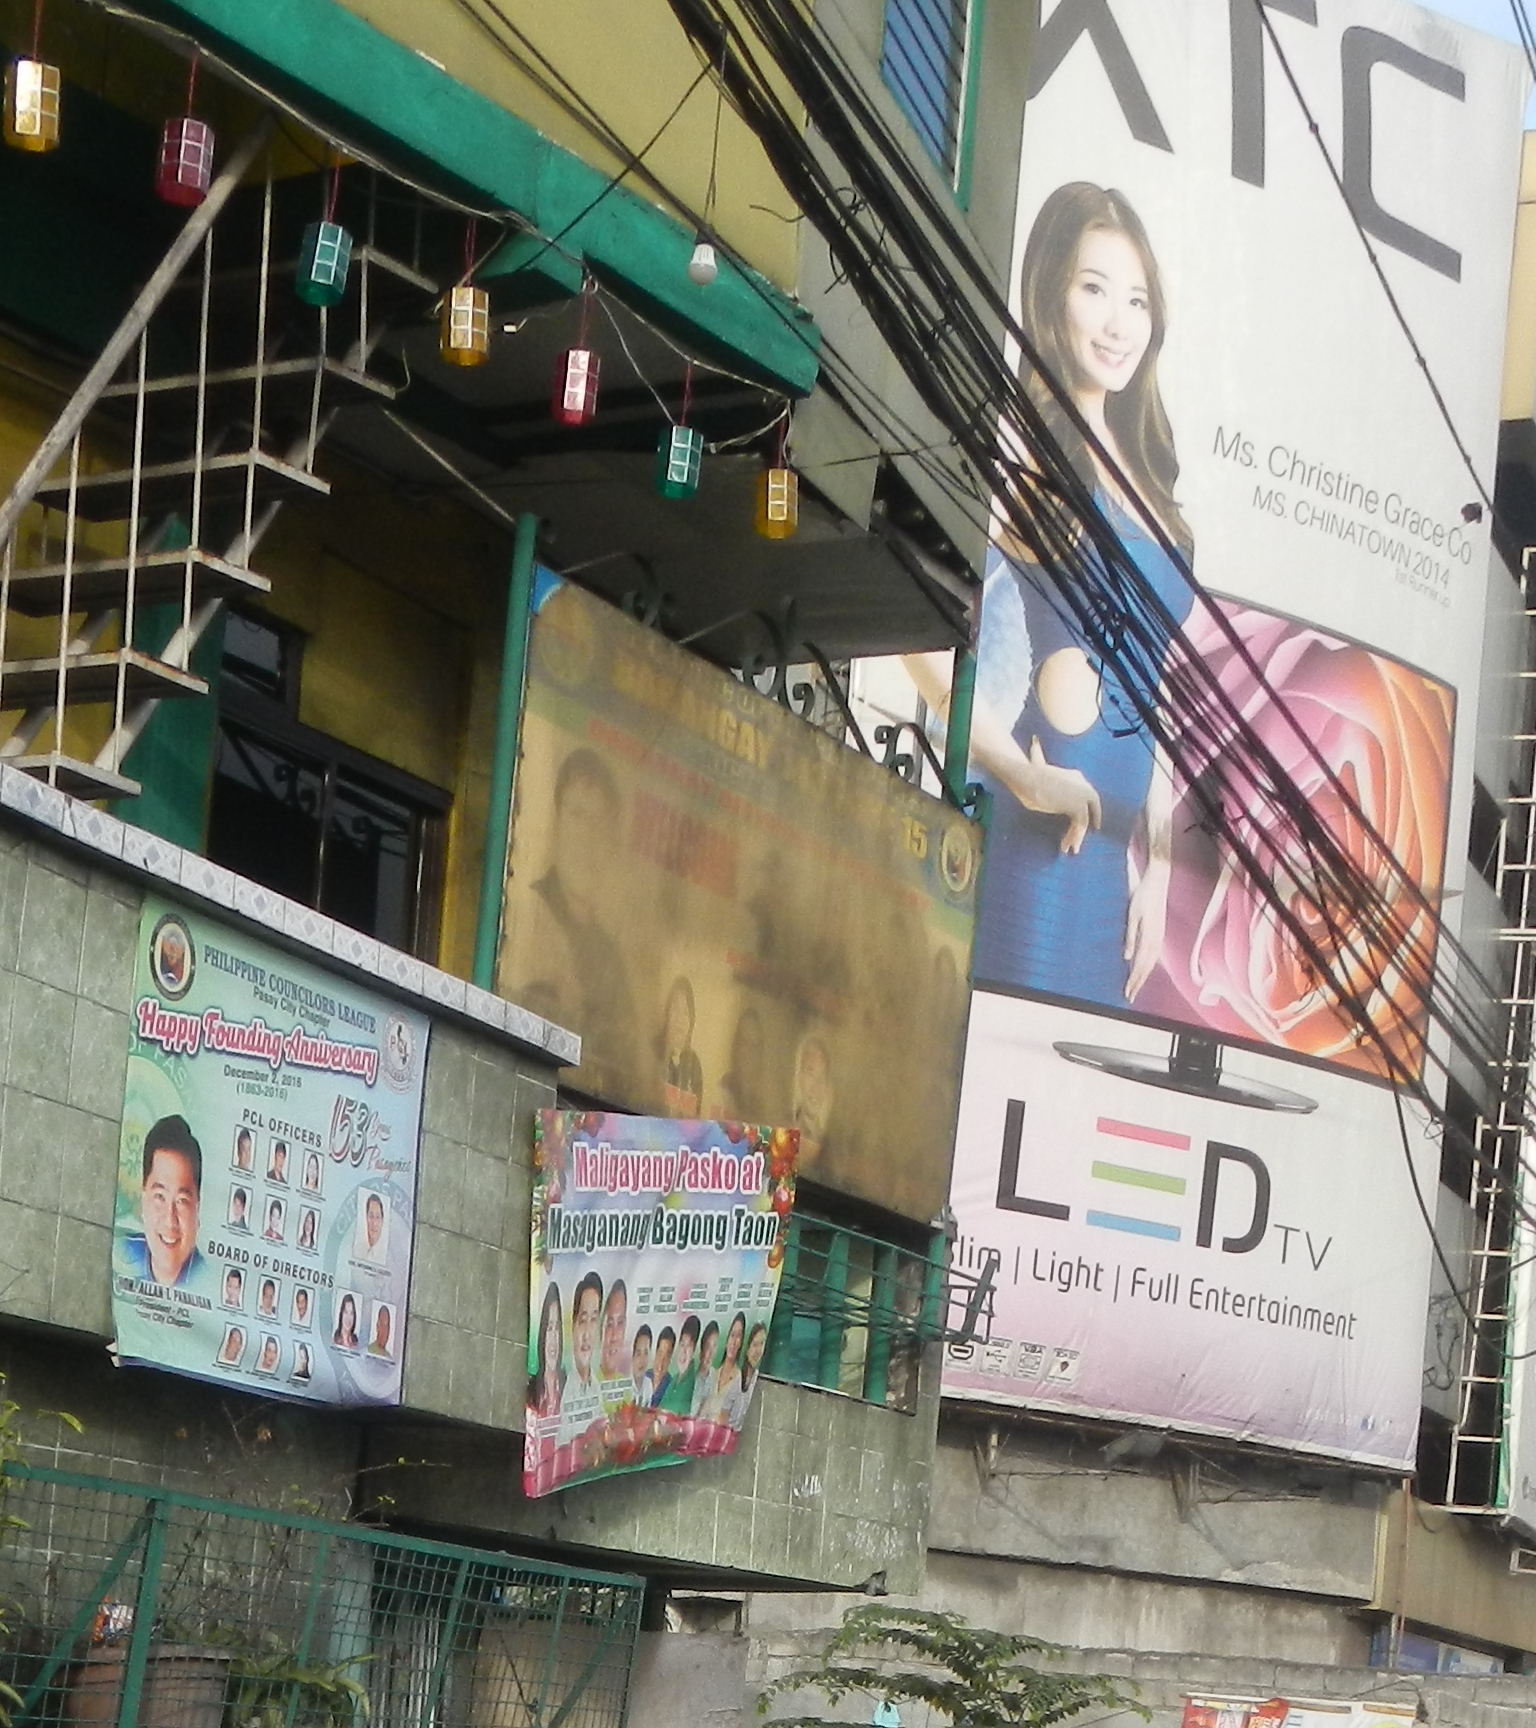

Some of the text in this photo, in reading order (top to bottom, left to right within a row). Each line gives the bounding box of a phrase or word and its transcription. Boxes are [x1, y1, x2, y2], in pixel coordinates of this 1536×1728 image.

[1213, 426, 1472, 565] Ms. Christine Grace Co
[1252, 485, 1450, 589] MS. CHINATOWN 2014
[204, 945, 376, 1034] PHILIPPINE COUNCILORS LEAGUE
[253, 985, 331, 1029] Pasay City Chapter
[138, 998, 379, 1085] Happy Founding Anniversary
[223, 1064, 270, 1084] December
[281, 1073, 303, 1088] 2016
[242, 1108, 323, 1148] PCL OFFICERS
[573, 1144, 764, 1193] Maligayang Pasko at
[996, 1098, 1333, 1272] LED TV
[547, 1205, 779, 1253] Masaganang Bagong Taon
[208, 1240, 250, 1264] BOARD
[253, 1253, 269, 1269] OF
[272, 1259, 335, 1288] DIRECTORS
[958, 1235, 1359, 1341] lim Light Full Entertainment
[138, 1281, 164, 1299] ALLAN
[152, 1312, 166, 1326] City
[167, 1316, 194, 1329] Chapter
